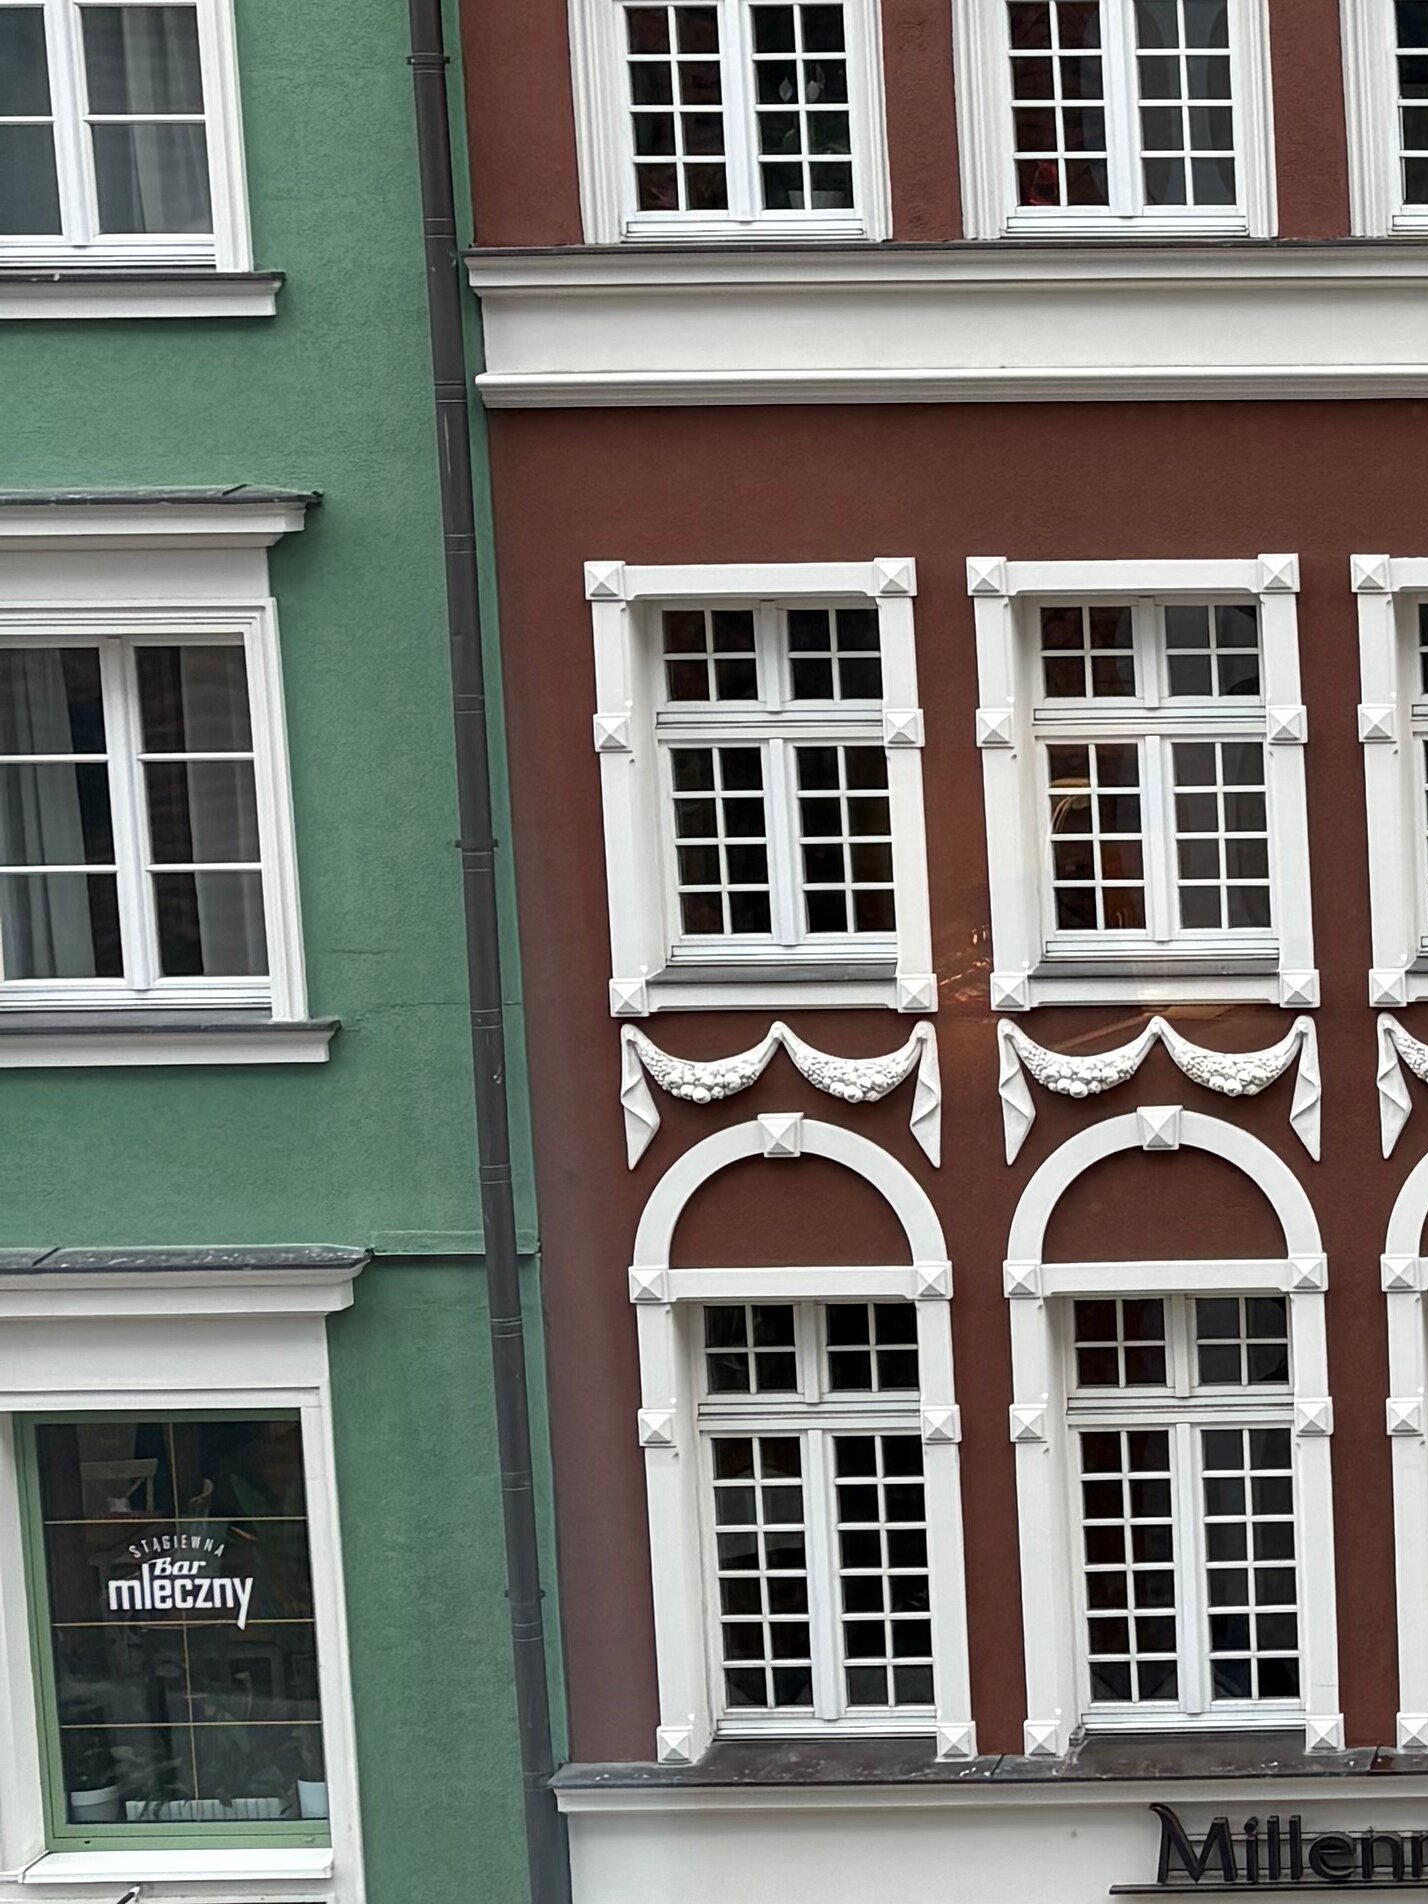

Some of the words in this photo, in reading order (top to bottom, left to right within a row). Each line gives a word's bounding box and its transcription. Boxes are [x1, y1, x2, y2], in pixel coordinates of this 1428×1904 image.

[129, 1535, 224, 1558] STĄGIEWNA
[148, 1557, 206, 1576] Bar
[108, 1563, 253, 1630] mleczny
